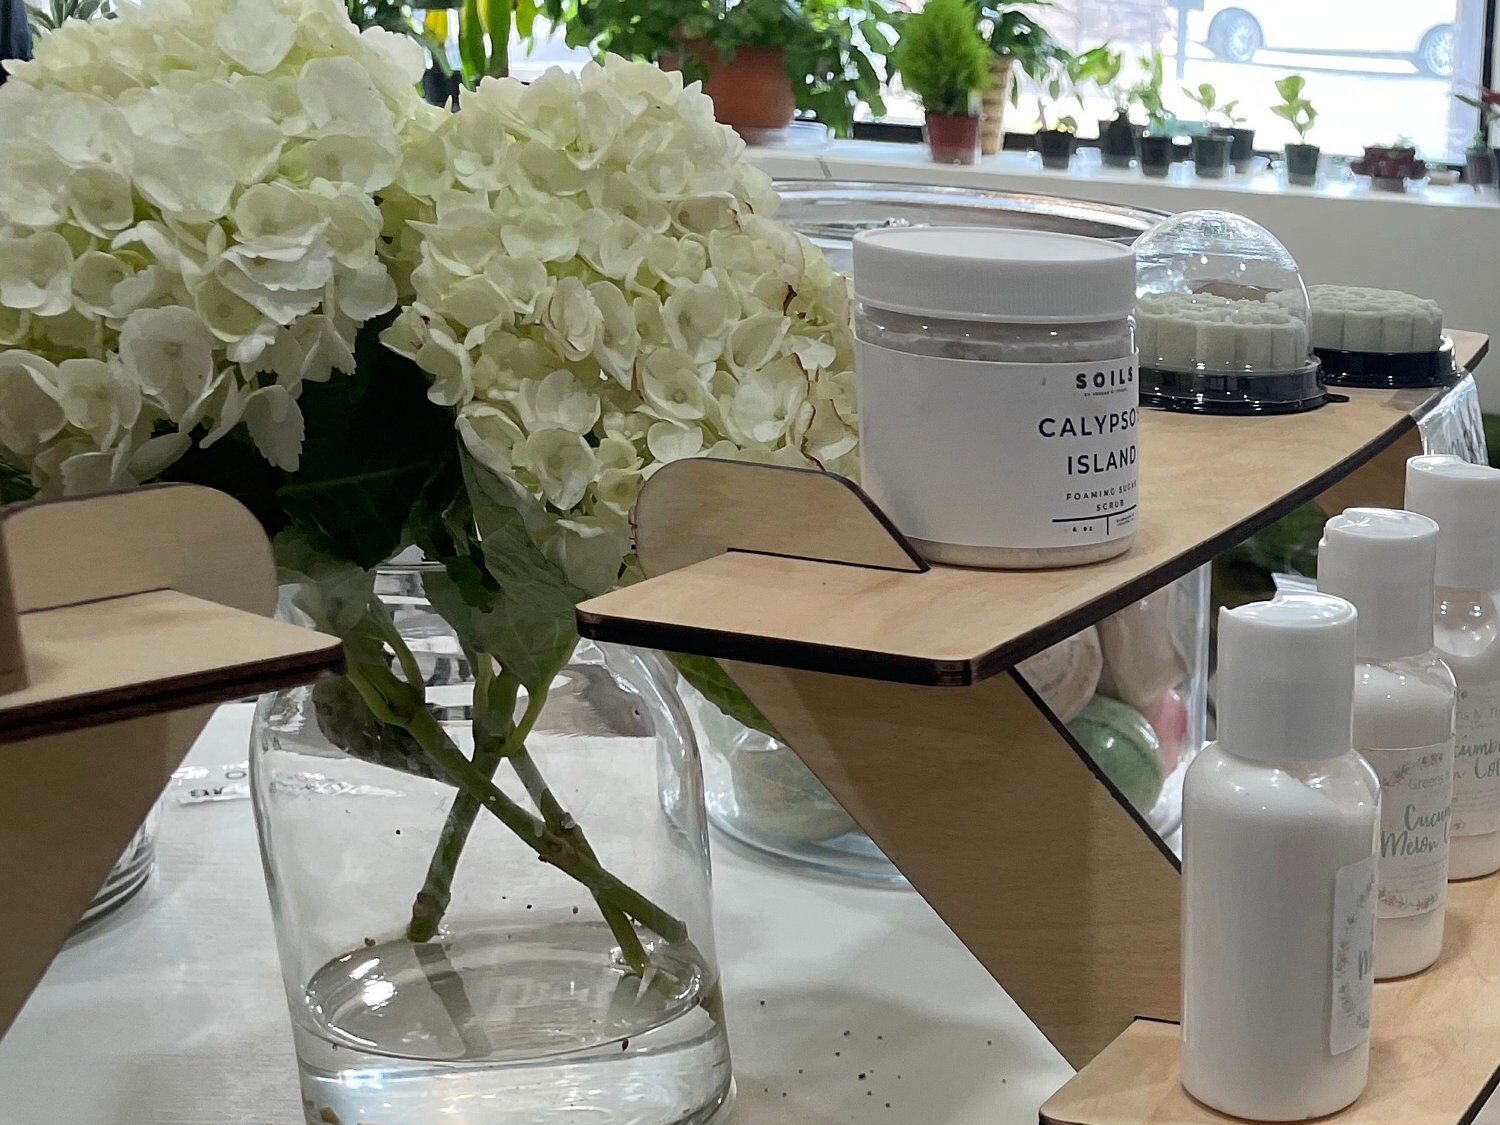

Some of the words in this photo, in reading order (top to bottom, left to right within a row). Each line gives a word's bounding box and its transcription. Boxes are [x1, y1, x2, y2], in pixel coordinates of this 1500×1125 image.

[1075, 366, 1133, 389] SOILS
[1038, 407, 1136, 438] CALYPSO
[1067, 444, 1136, 475] ISLAND
[1066, 487, 1116, 501] FOAMING
[1095, 498, 1125, 512] SCRUB
[1380, 830, 1440, 858] Melon
